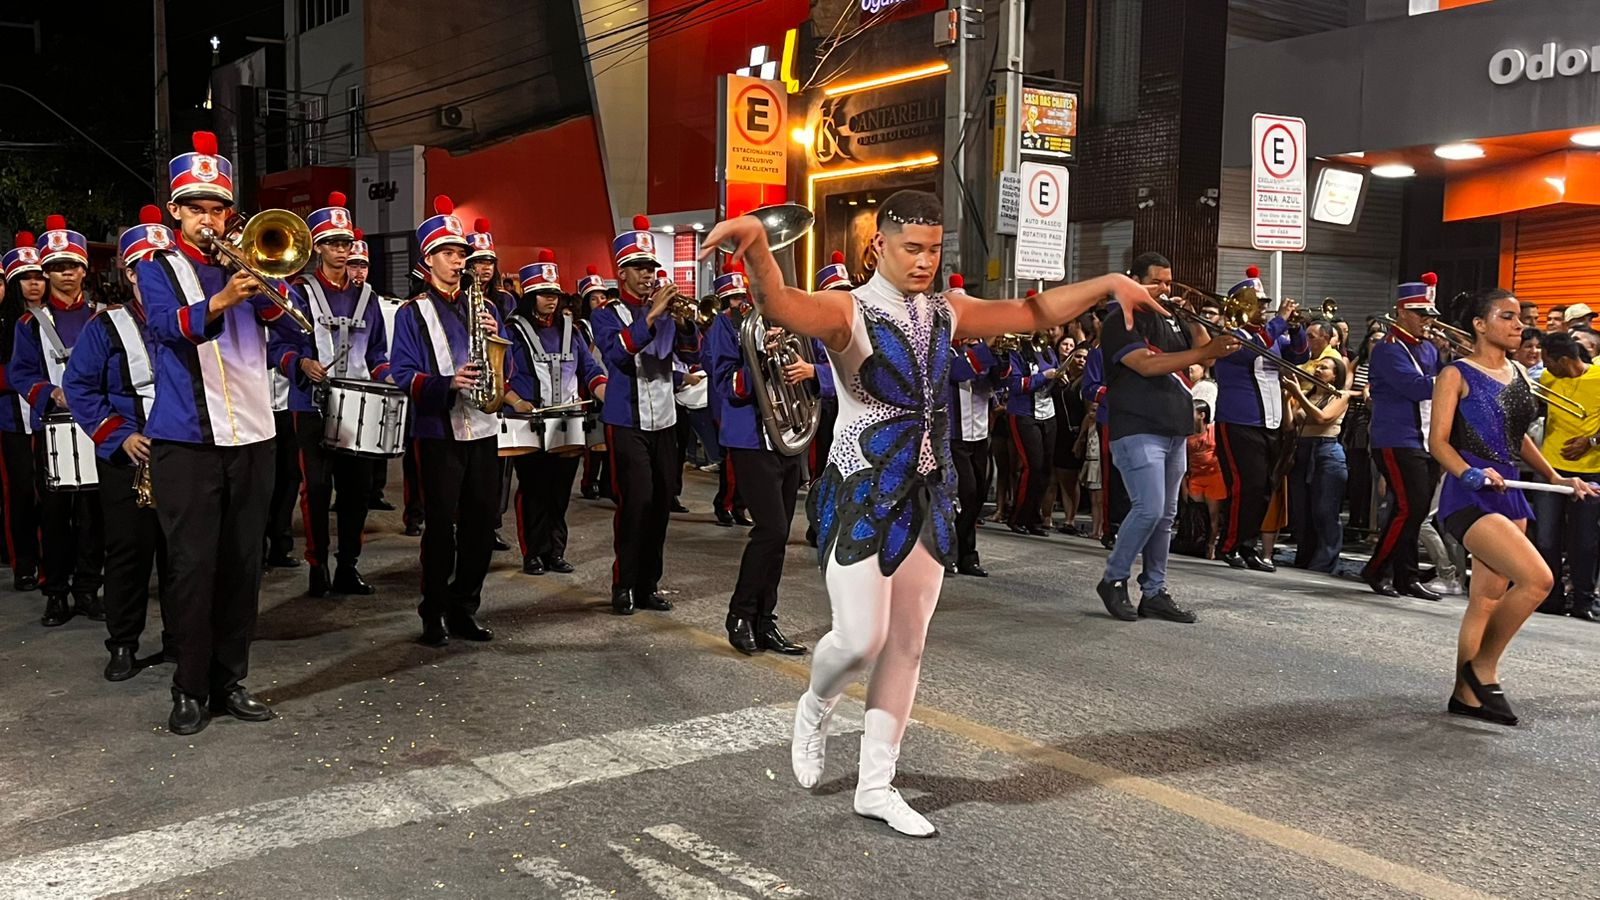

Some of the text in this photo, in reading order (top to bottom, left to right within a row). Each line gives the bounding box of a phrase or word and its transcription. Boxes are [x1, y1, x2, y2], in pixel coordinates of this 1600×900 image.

[1023, 93, 1039, 106] CASA
[1051, 97, 1073, 110] CHAVES
[747, 97, 769, 132] E
[848, 100, 939, 132] CANTARELLI
[732, 146, 783, 157] ESTACIONAMENTO
[1273, 137, 1285, 165] E
[742, 156, 773, 165] EXCLUSIVO
[751, 166, 779, 174] CLIENTES
[1039, 181, 1049, 206] E
[1258, 194, 1300, 204] ZONA AZUL
[1041, 220, 1062, 228] PASSEIO
[1022, 230, 1047, 239] ROTATIVO
